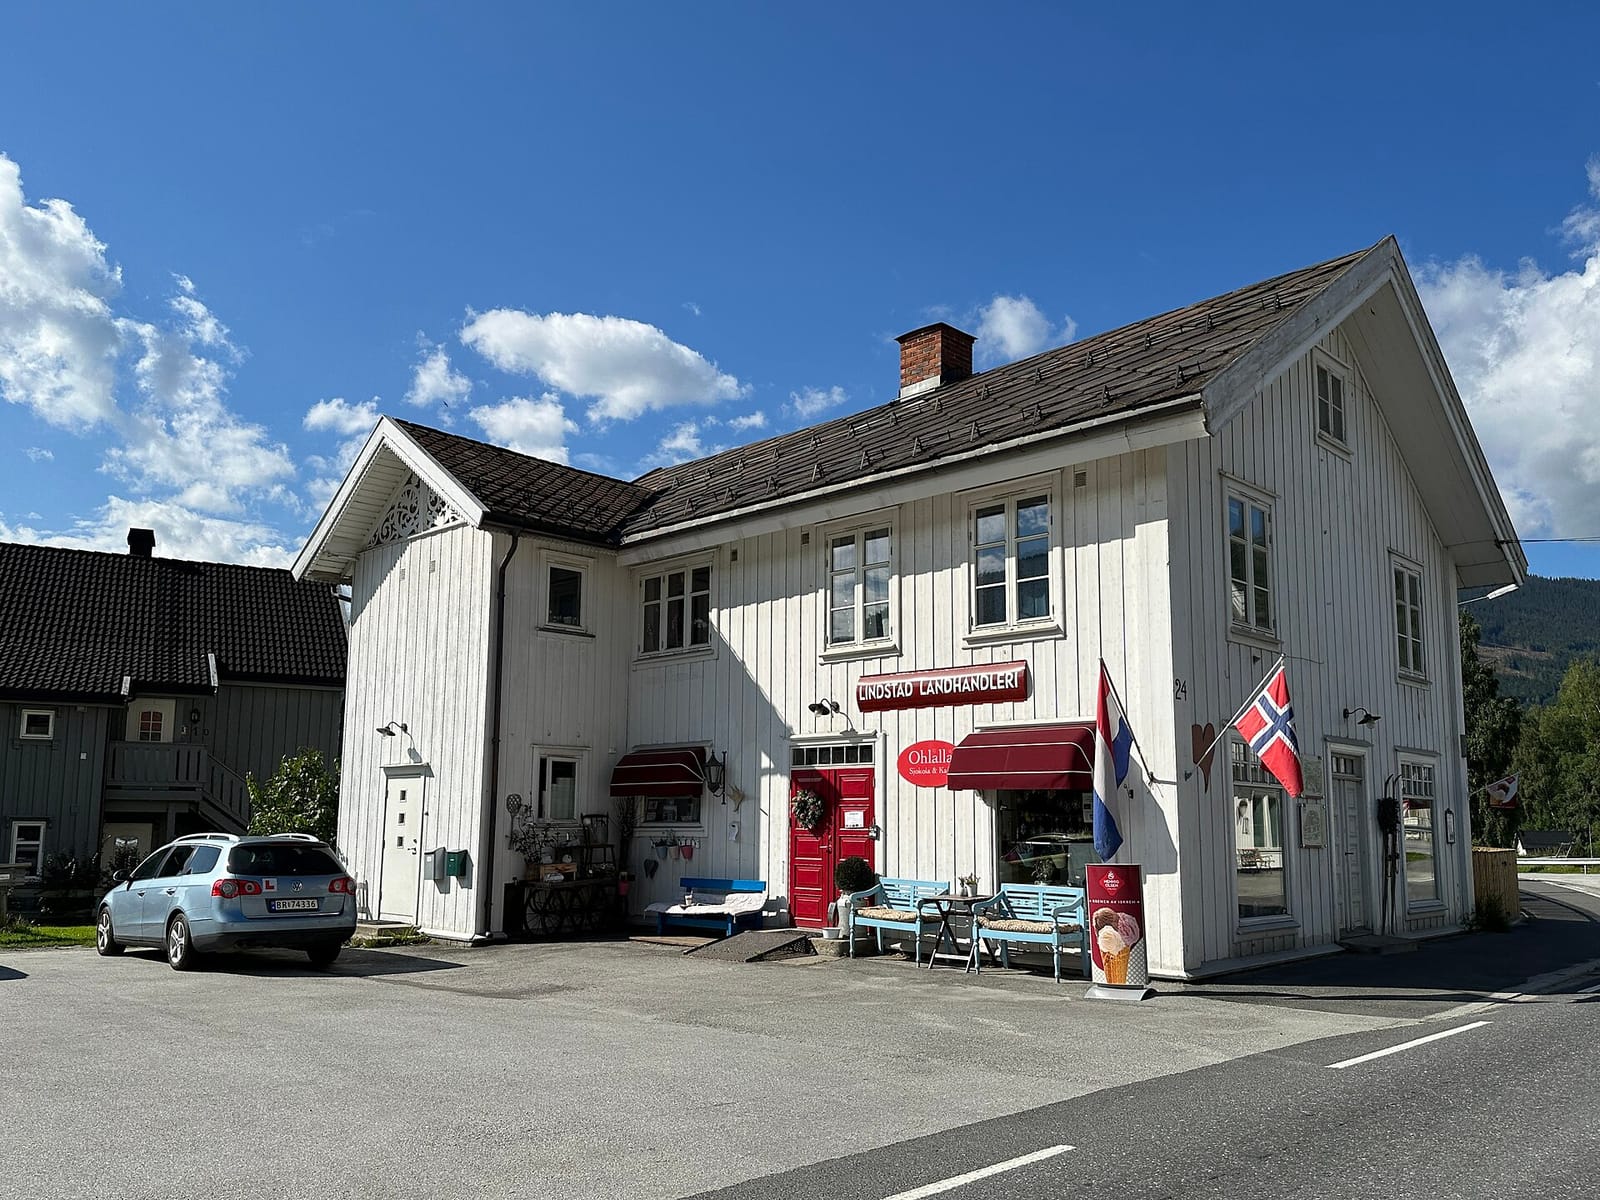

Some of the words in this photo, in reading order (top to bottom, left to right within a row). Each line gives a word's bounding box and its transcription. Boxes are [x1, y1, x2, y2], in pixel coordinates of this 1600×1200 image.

[859, 681, 913, 701] LINDSTAD
[919, 671, 1018, 696] LANDHANDLERI
[1175, 678, 1187, 701] 24
[265, 880, 274, 890] L
